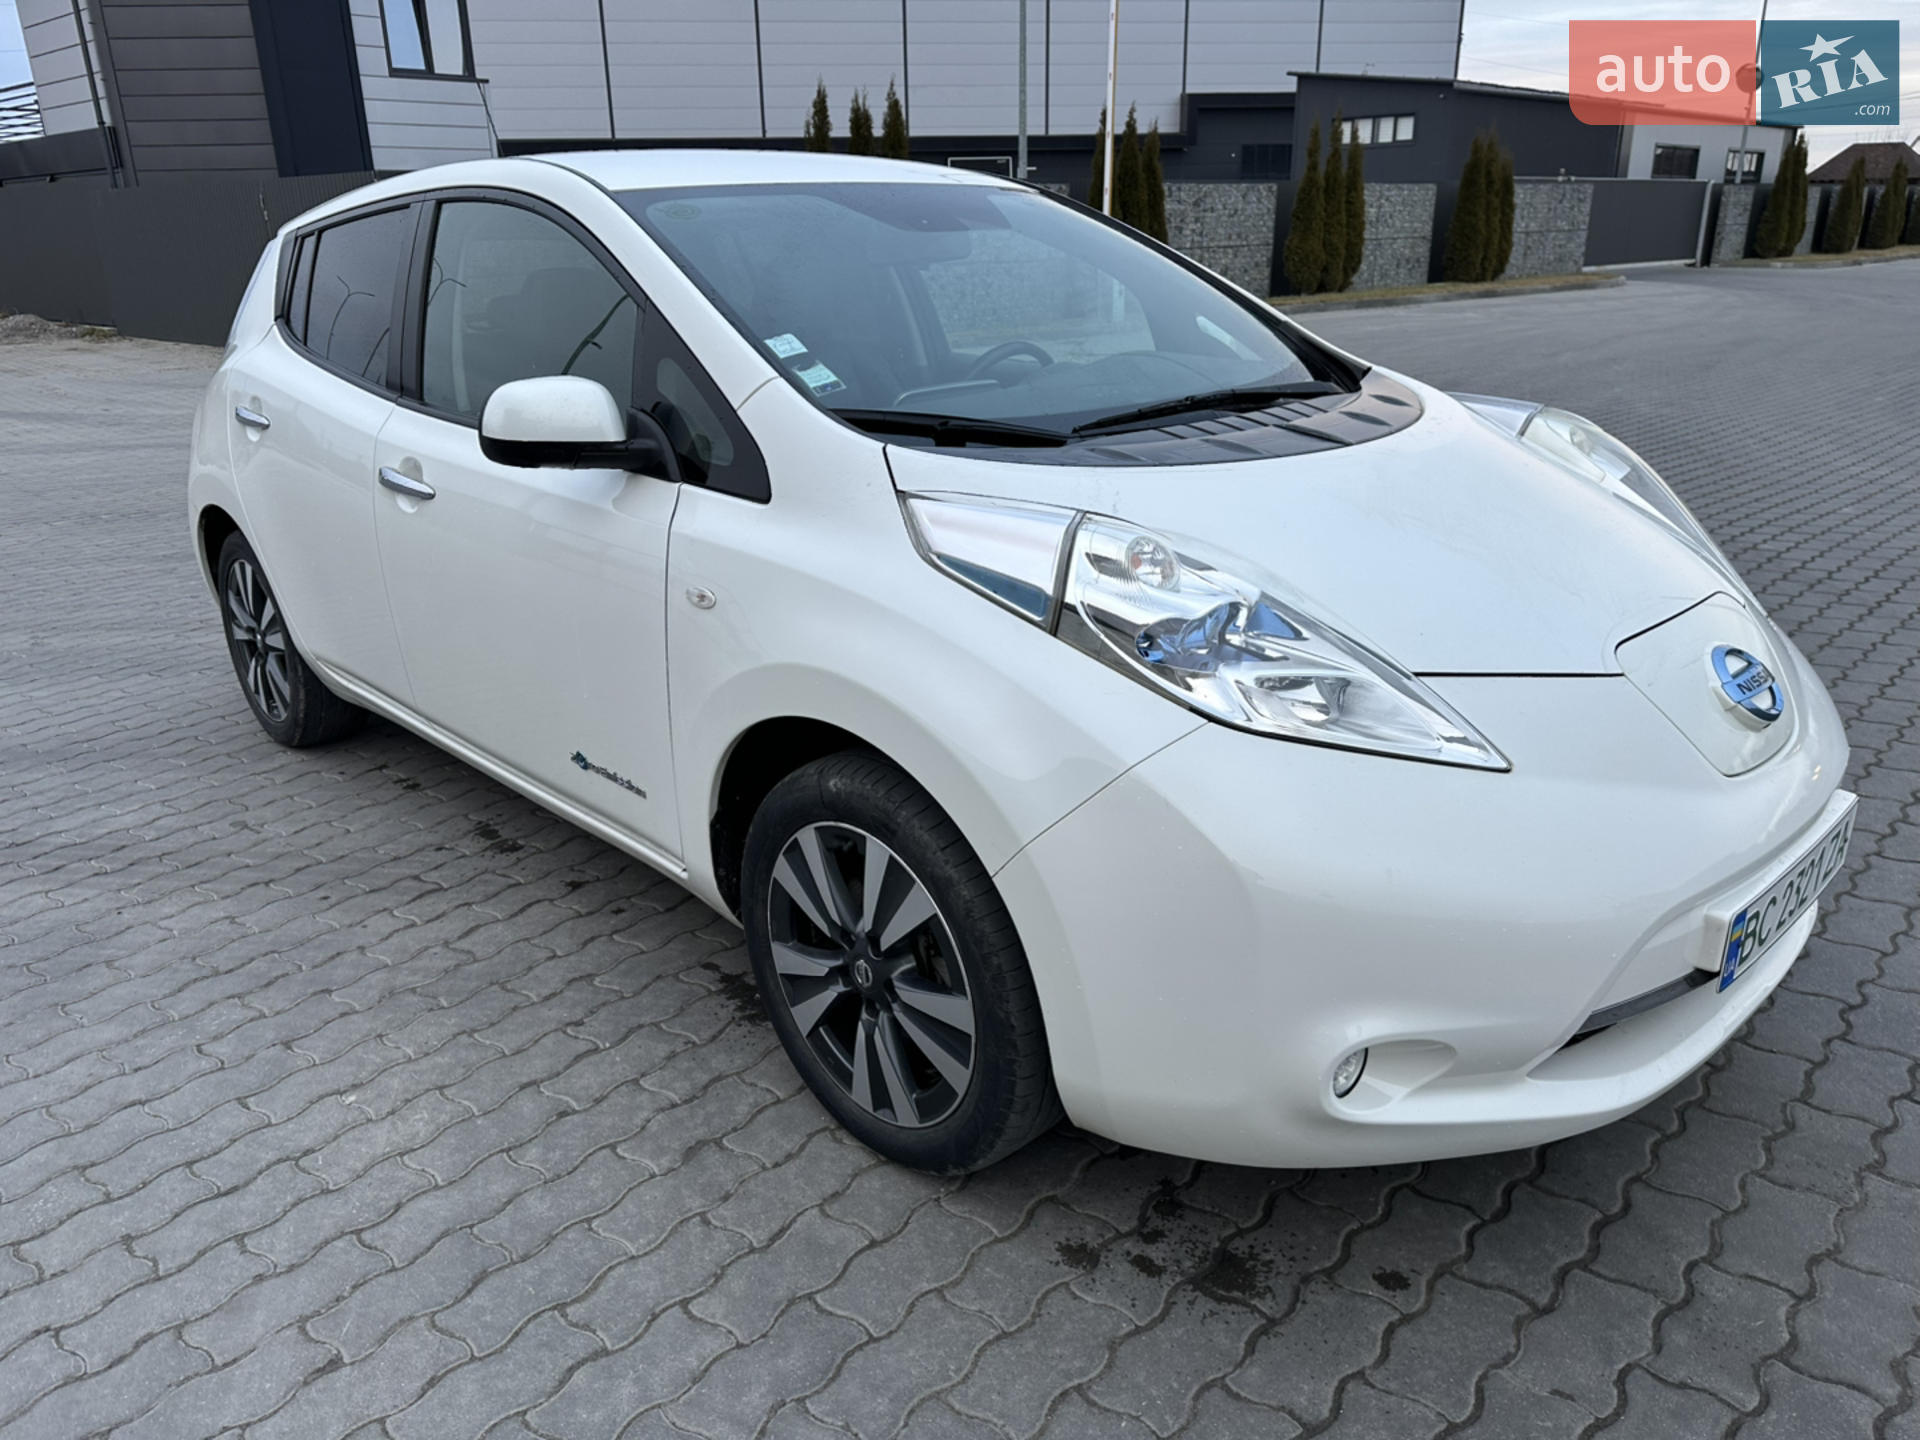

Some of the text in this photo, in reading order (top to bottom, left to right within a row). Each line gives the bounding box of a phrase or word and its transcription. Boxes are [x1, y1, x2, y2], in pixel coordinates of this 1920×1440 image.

[1736, 669, 1768, 695] NISS
[1738, 896, 1777, 967] BC
[1776, 846, 1825, 932] 2321
